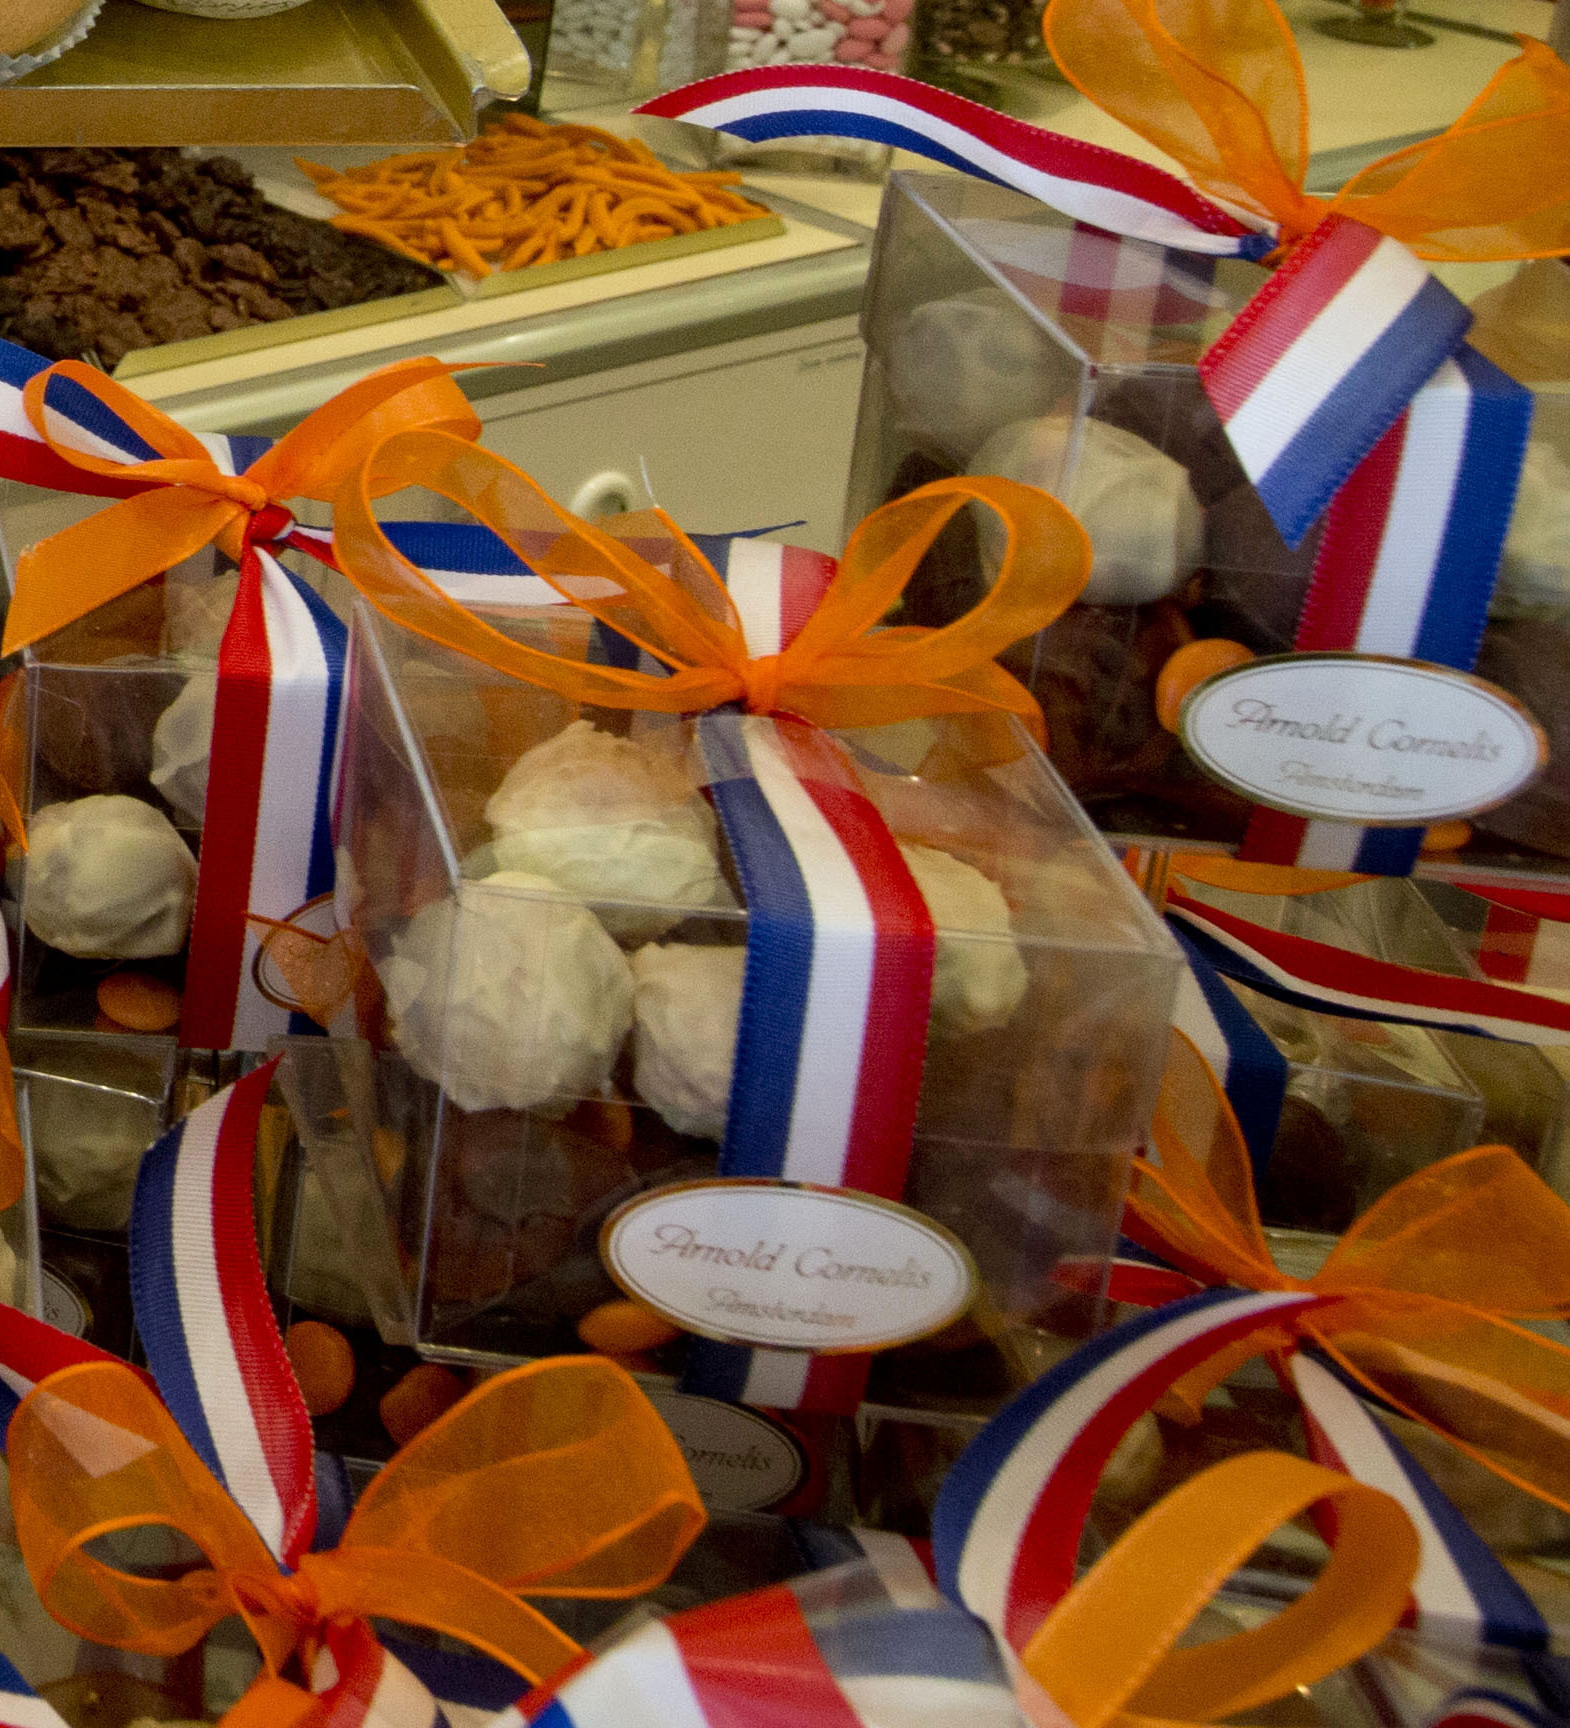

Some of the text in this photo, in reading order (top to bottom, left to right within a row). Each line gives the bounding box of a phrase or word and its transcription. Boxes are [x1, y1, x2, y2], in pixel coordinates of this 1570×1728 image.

[1227, 697, 1504, 763] Arnold Cornelis
[649, 1222, 932, 1289] Arnold Cornelis
[675, 1433, 773, 1472] ornelis
